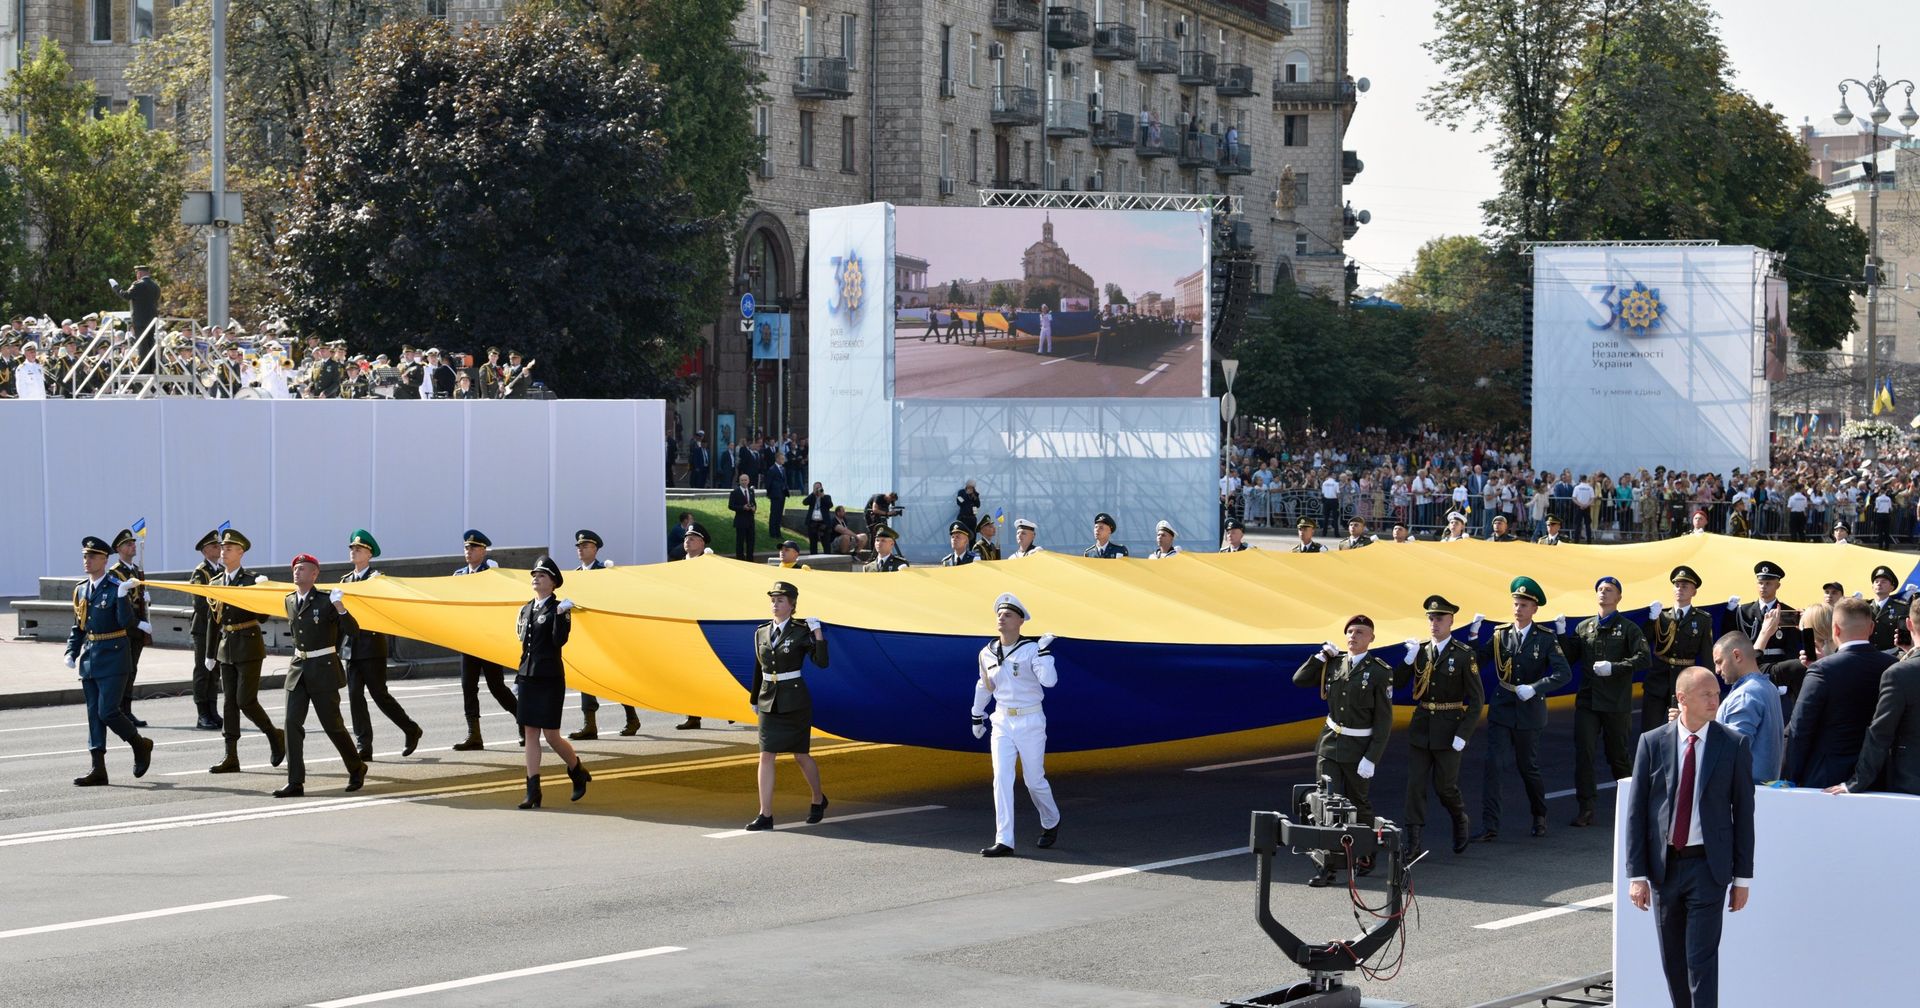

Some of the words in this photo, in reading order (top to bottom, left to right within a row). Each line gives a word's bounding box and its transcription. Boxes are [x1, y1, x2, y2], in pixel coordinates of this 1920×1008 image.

[1592, 341, 1619, 350] років
[1592, 350, 1664, 359] Незалежності
[1592, 359, 1633, 370] України
[1591, 387, 1601, 396] Ти
